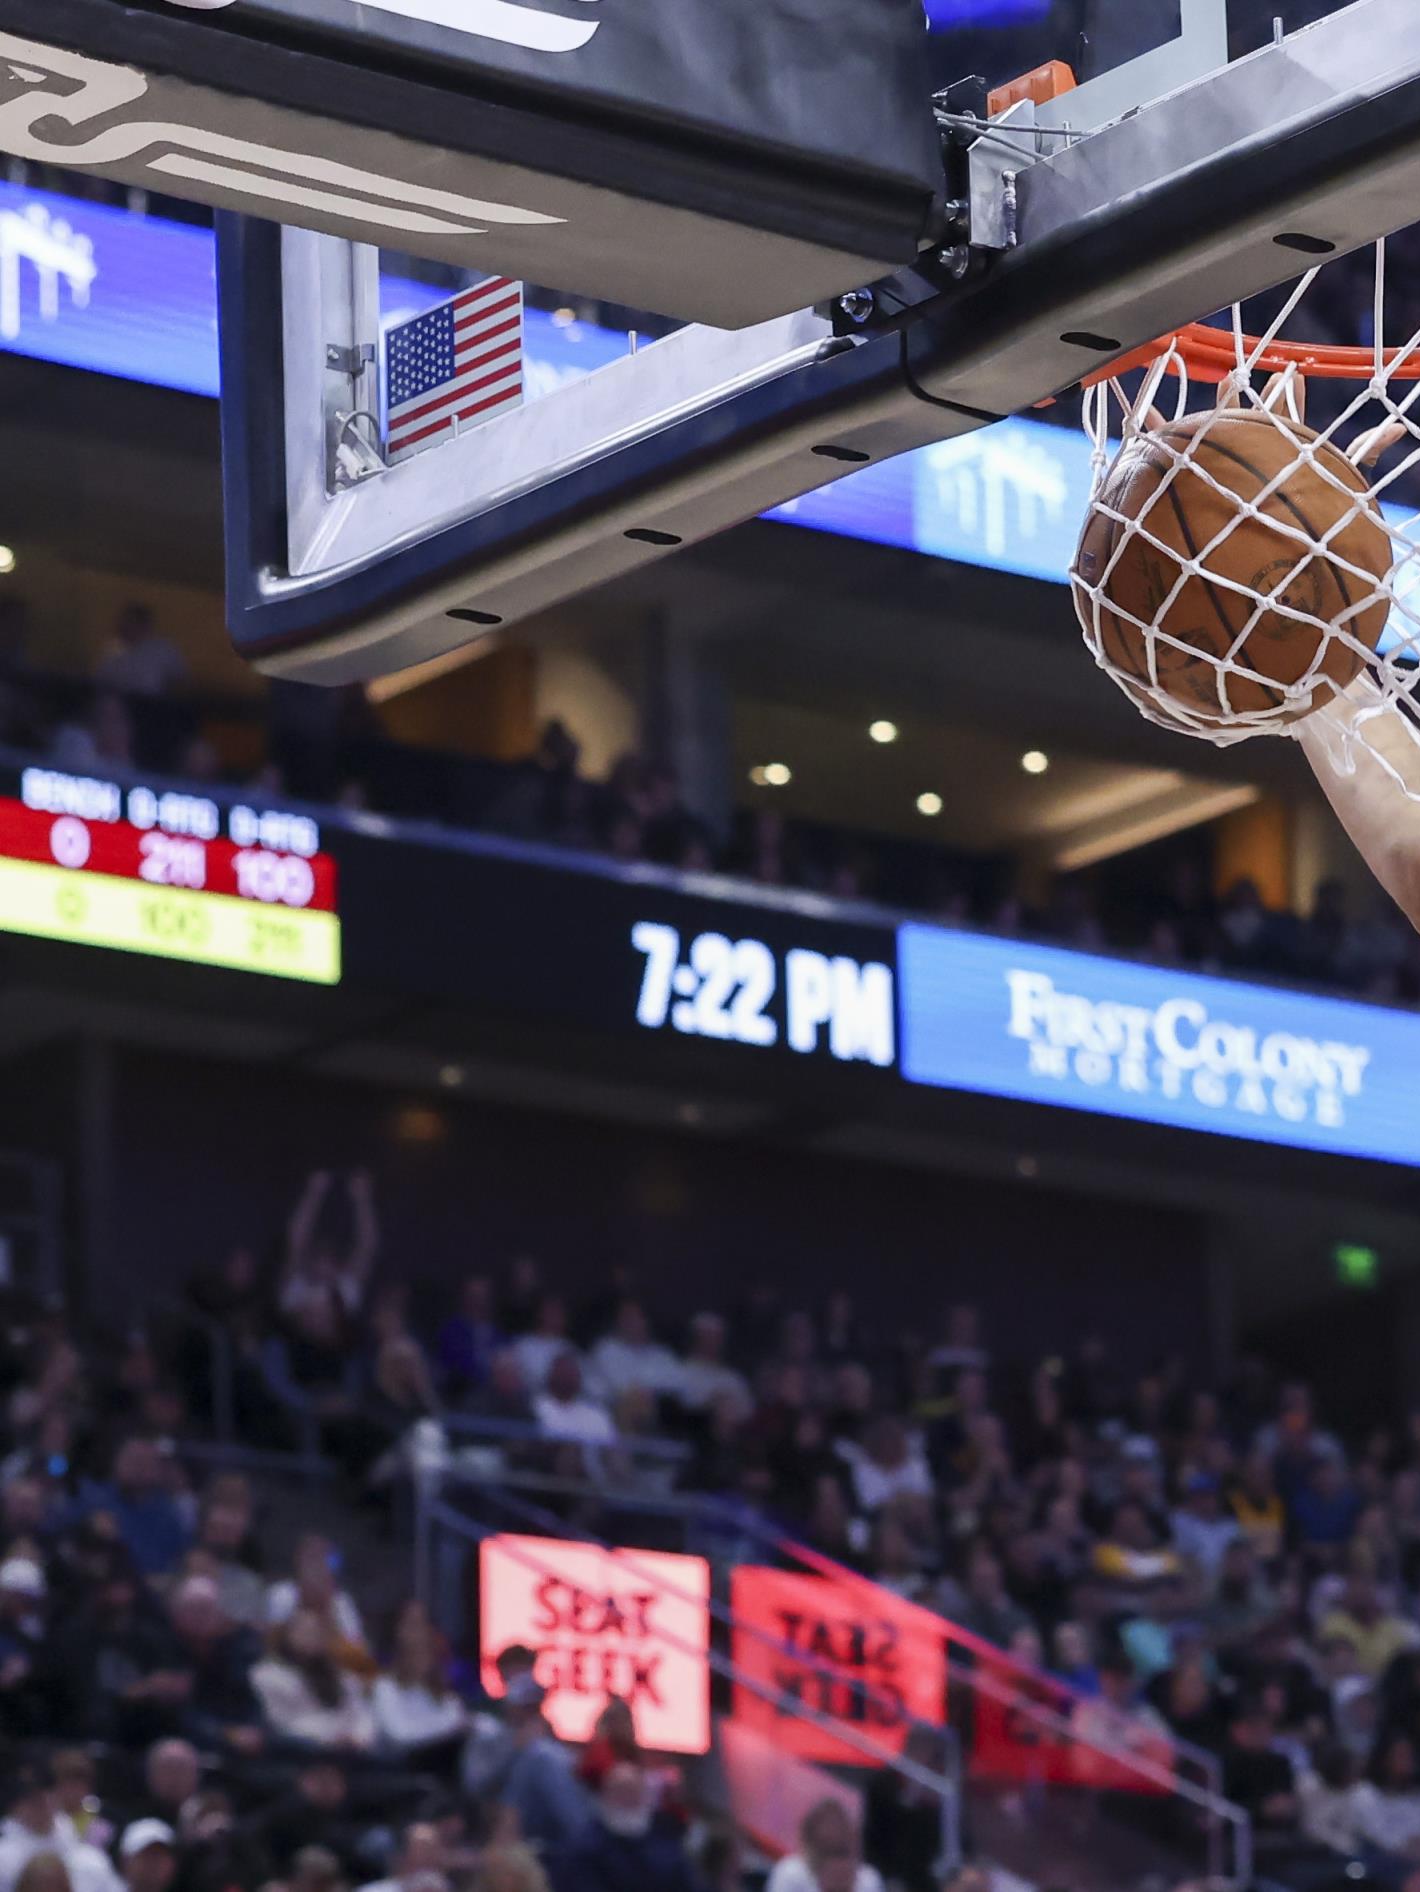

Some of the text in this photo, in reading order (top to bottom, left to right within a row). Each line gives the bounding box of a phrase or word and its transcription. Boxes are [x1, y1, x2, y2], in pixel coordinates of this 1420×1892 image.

[631, 921, 895, 1066] 7:22 PM
[1029, 1040, 1344, 1128] MORTGAGE
[534, 1577, 656, 1637] SEAT
[537, 1646, 661, 1708] GEEK
